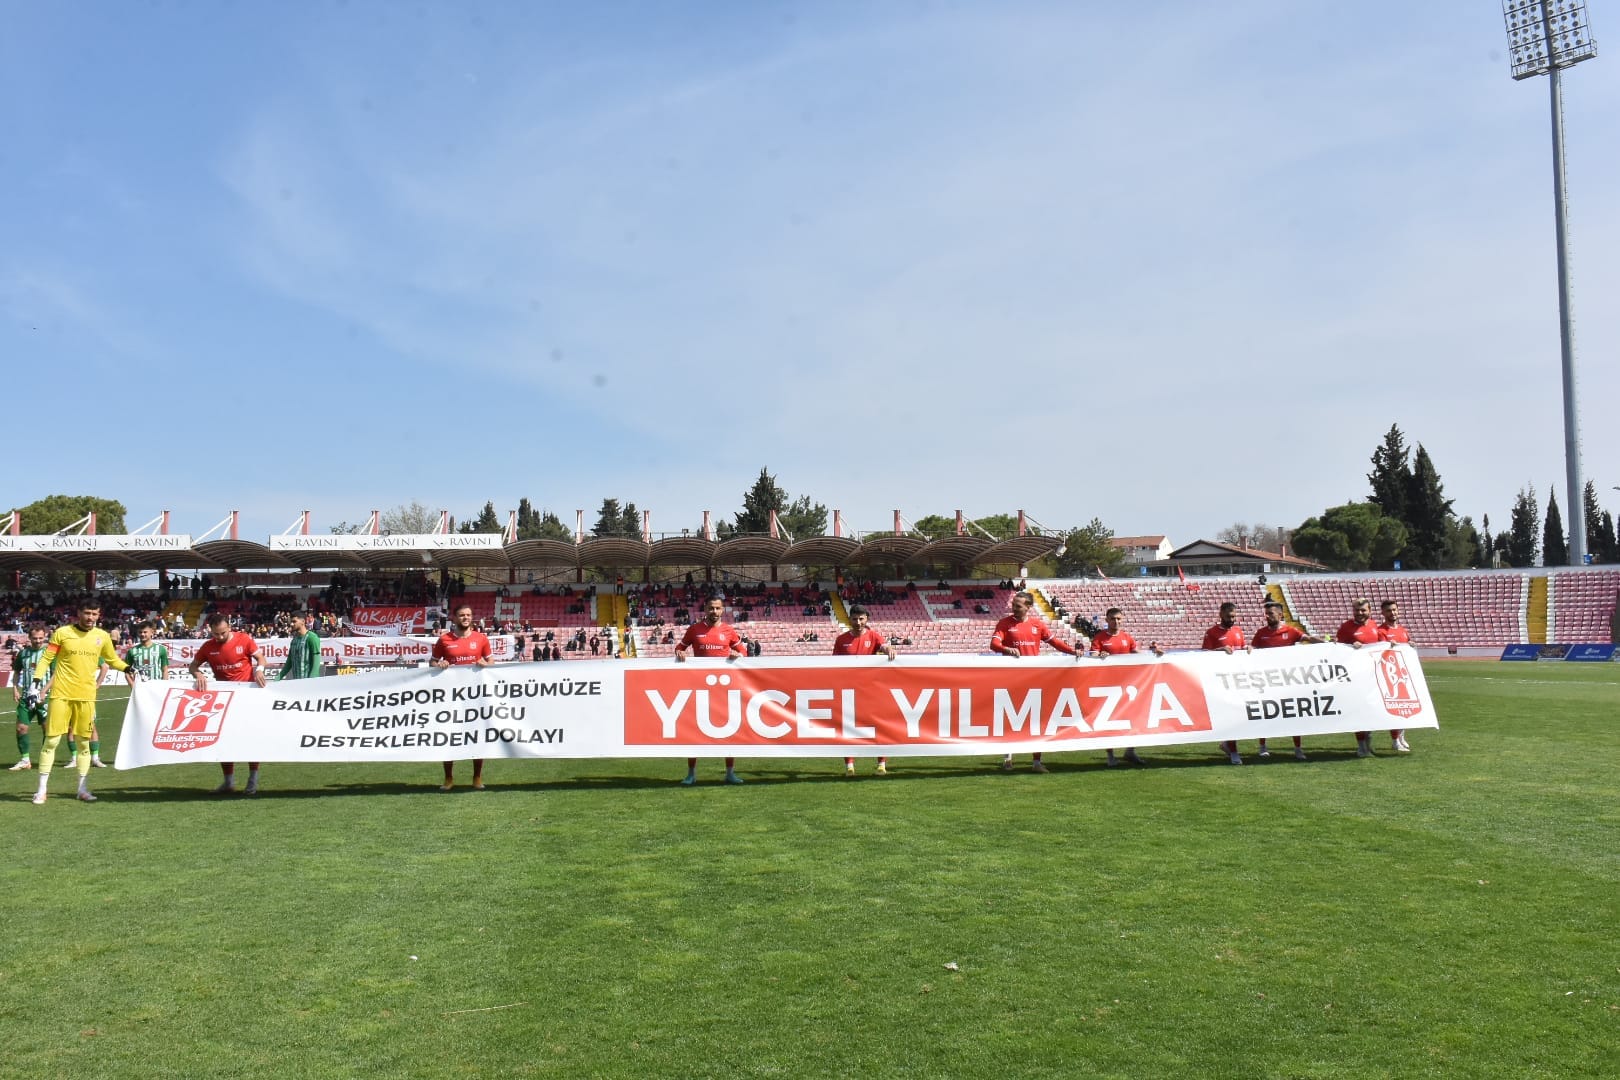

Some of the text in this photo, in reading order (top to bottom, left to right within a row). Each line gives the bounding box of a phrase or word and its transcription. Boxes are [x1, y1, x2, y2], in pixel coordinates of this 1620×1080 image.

[52, 538, 97, 548] RAVINI
[134, 537, 179, 547] RAVINI
[295, 537, 338, 547] RAVINI
[373, 537, 415, 547] RAVINI
[449, 537, 491, 546] RAVINI
[344, 644, 364, 657] Biz
[367, 643, 428, 656] Tribünde
[1216, 659, 1352, 693] TEŞEKKÜR
[272, 678, 602, 712] BALIKESİRSPOR KULÜBÜMÜZE
[645, 674, 876, 739] YÜCEL
[1246, 690, 1342, 720] EDERİZ.
[347, 703, 526, 730] VERMİŞ OLDUĞU
[300, 727, 564, 748] DESTEKLERDEN DOLAYI
